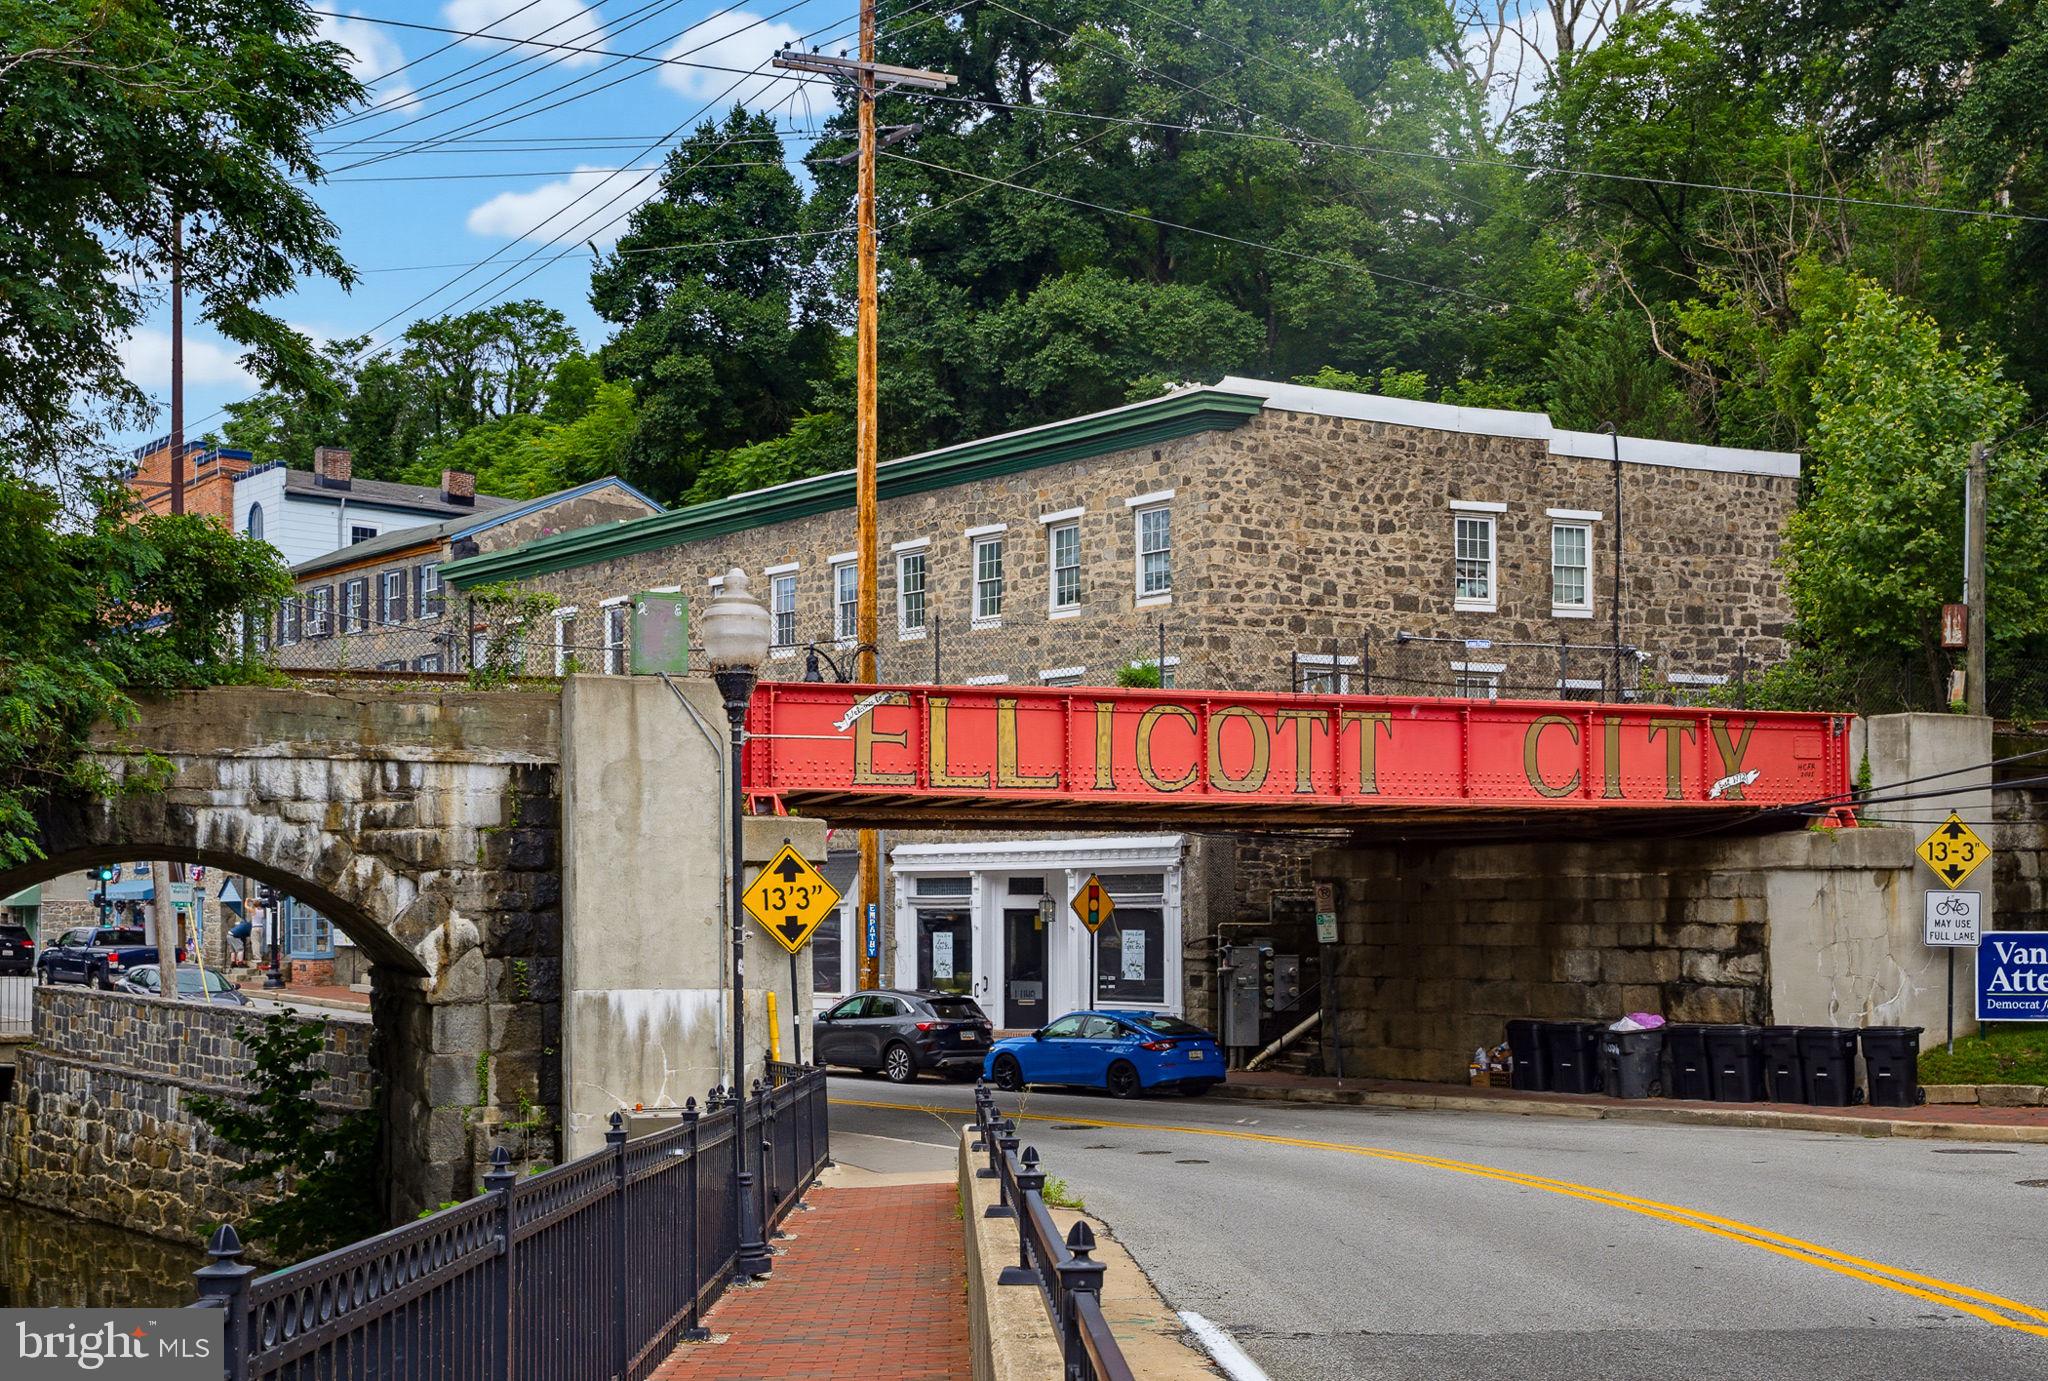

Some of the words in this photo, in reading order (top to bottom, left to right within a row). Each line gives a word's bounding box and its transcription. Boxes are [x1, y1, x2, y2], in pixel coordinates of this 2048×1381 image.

[846, 699, 875, 720] Welcome
[853, 691, 1393, 795] ELLICOTT
[1523, 713, 1758, 801] CITY
[1934, 919, 1951, 928] MAY
[1955, 919, 1972, 928] USE
[1930, 931, 1953, 941] FULL
[1954, 931, 1975, 941] LANE
[1993, 941, 2048, 964] Van
[1987, 998, 2040, 1009] Democrat
